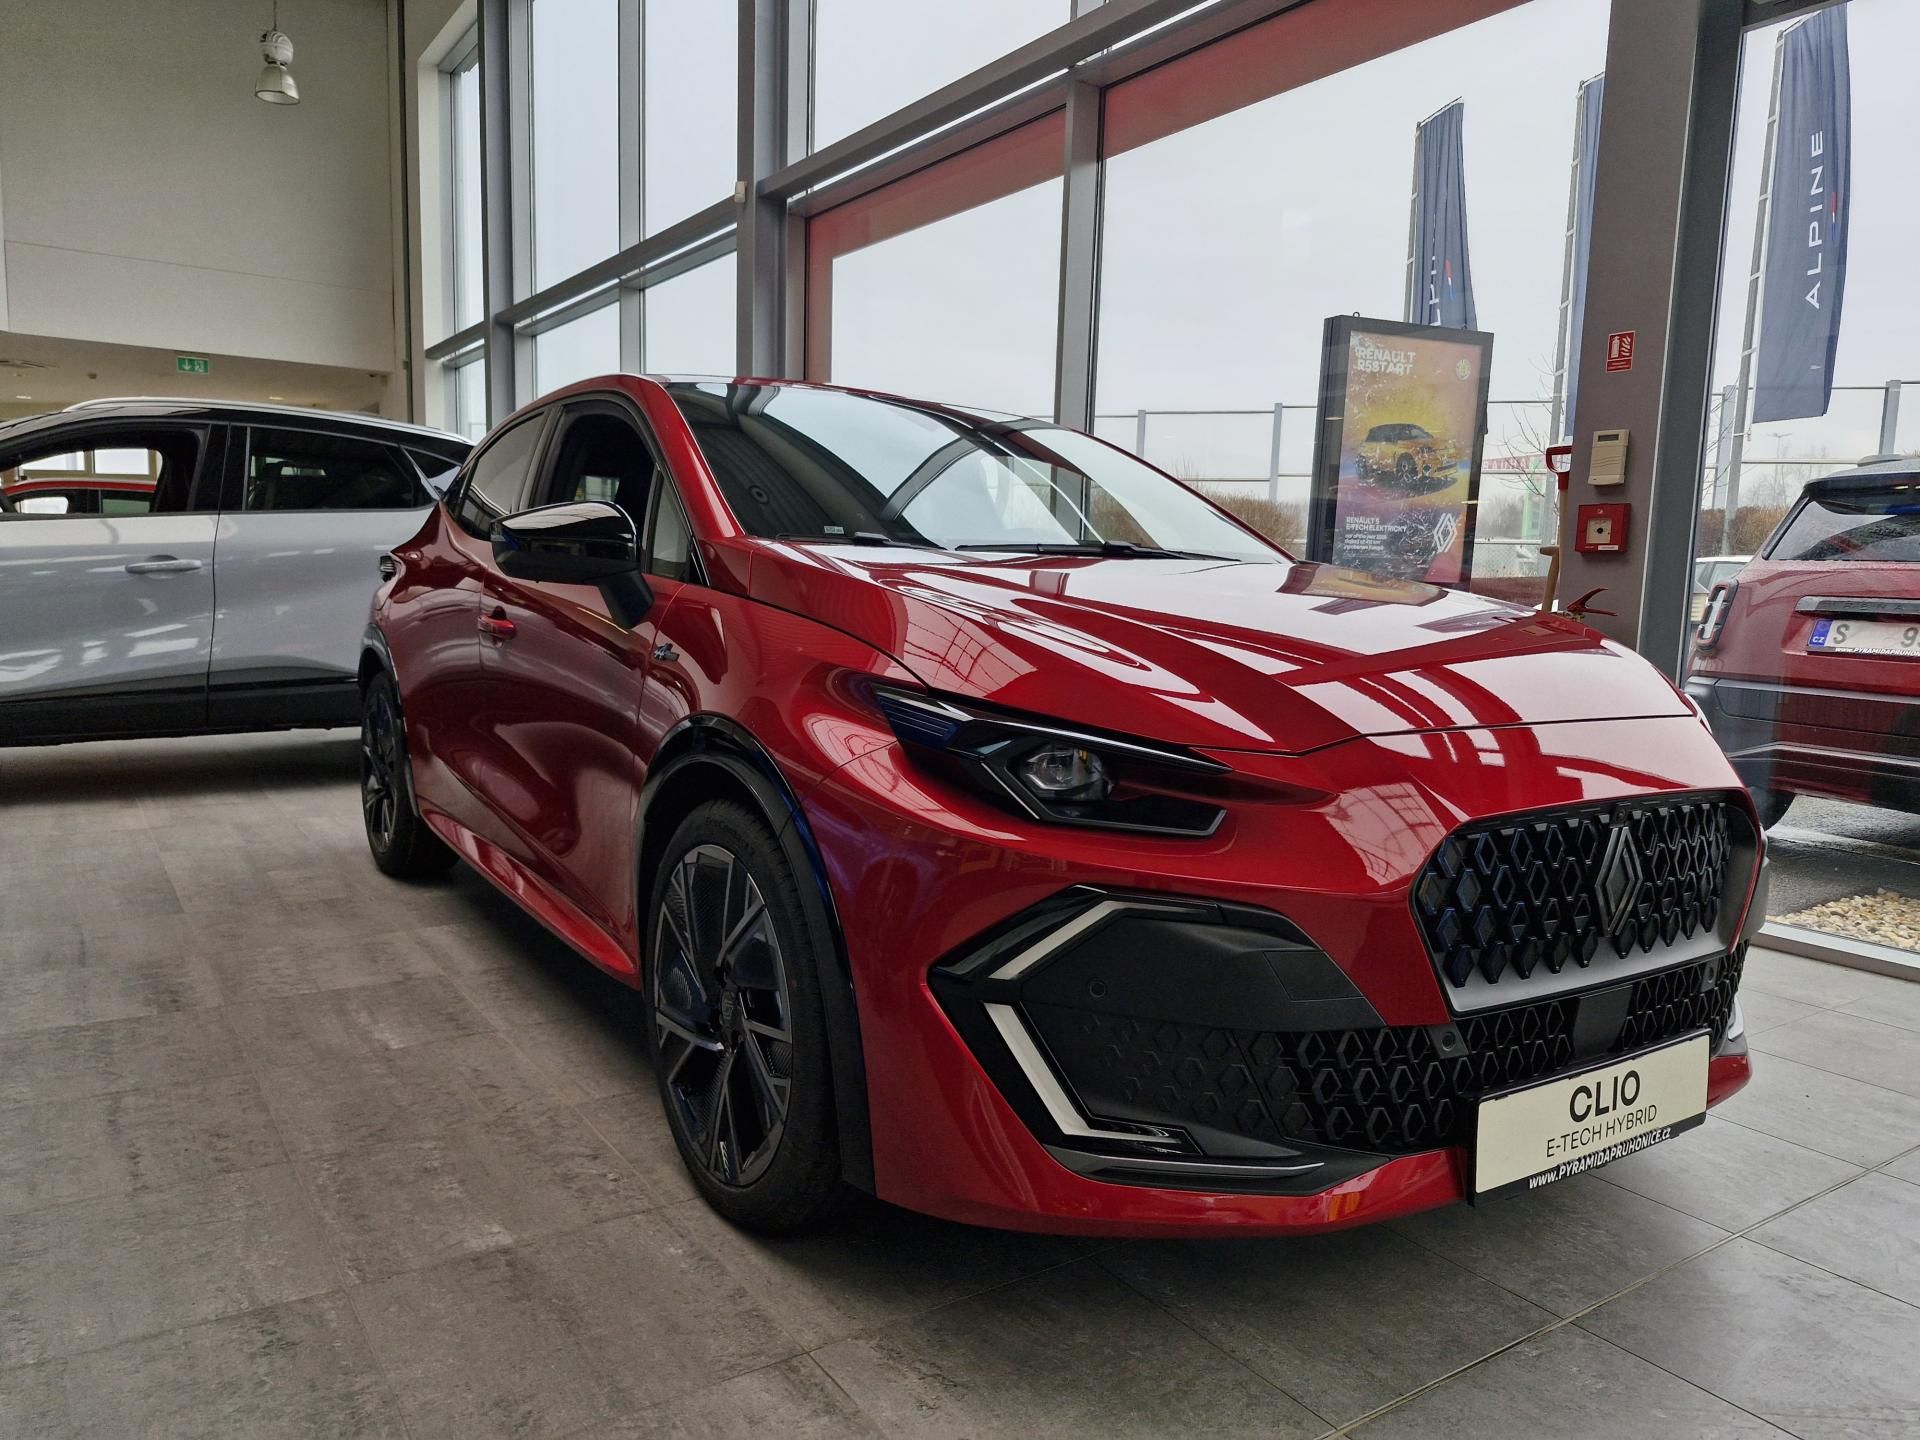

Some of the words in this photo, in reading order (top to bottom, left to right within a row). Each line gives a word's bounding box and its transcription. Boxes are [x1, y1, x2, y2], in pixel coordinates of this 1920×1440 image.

[1805, 131, 1824, 309] ALPINE
[1358, 347, 1416, 363] RENAULT
[1346, 516, 1375, 525] RENAULT
[1833, 623, 1850, 645] S
[1569, 1070, 1641, 1123] CLIO
[1546, 1123, 1602, 1158] E-TECH
[1606, 1104, 1658, 1138] HYBRID
